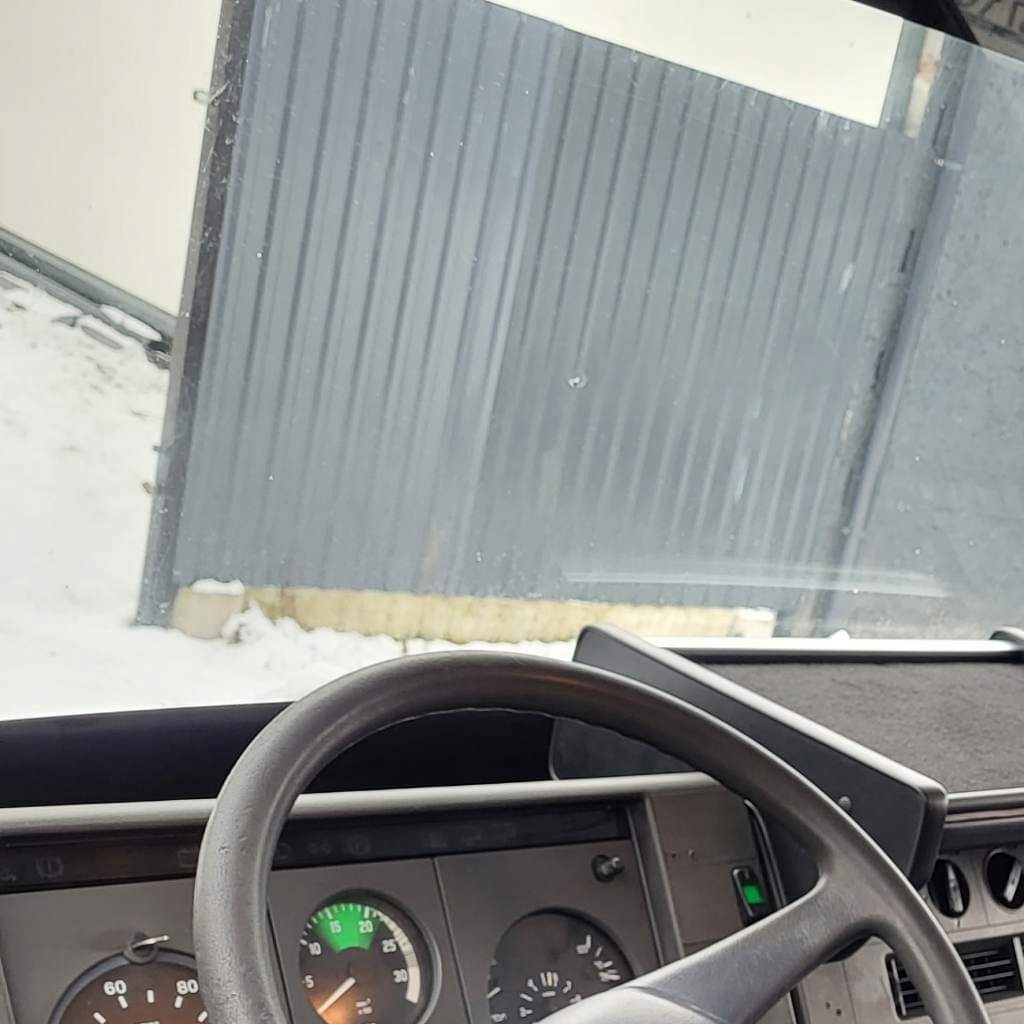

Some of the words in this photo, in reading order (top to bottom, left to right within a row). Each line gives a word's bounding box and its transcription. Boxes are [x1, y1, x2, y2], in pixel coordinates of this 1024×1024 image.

[330, 920, 342, 934] 15
[358, 920, 373, 933] 20
[309, 942, 322, 956] 10
[382, 939, 397, 953] 25
[393, 969, 408, 983] 30
[103, 980, 127, 996] 60
[176, 979, 199, 995] 80
